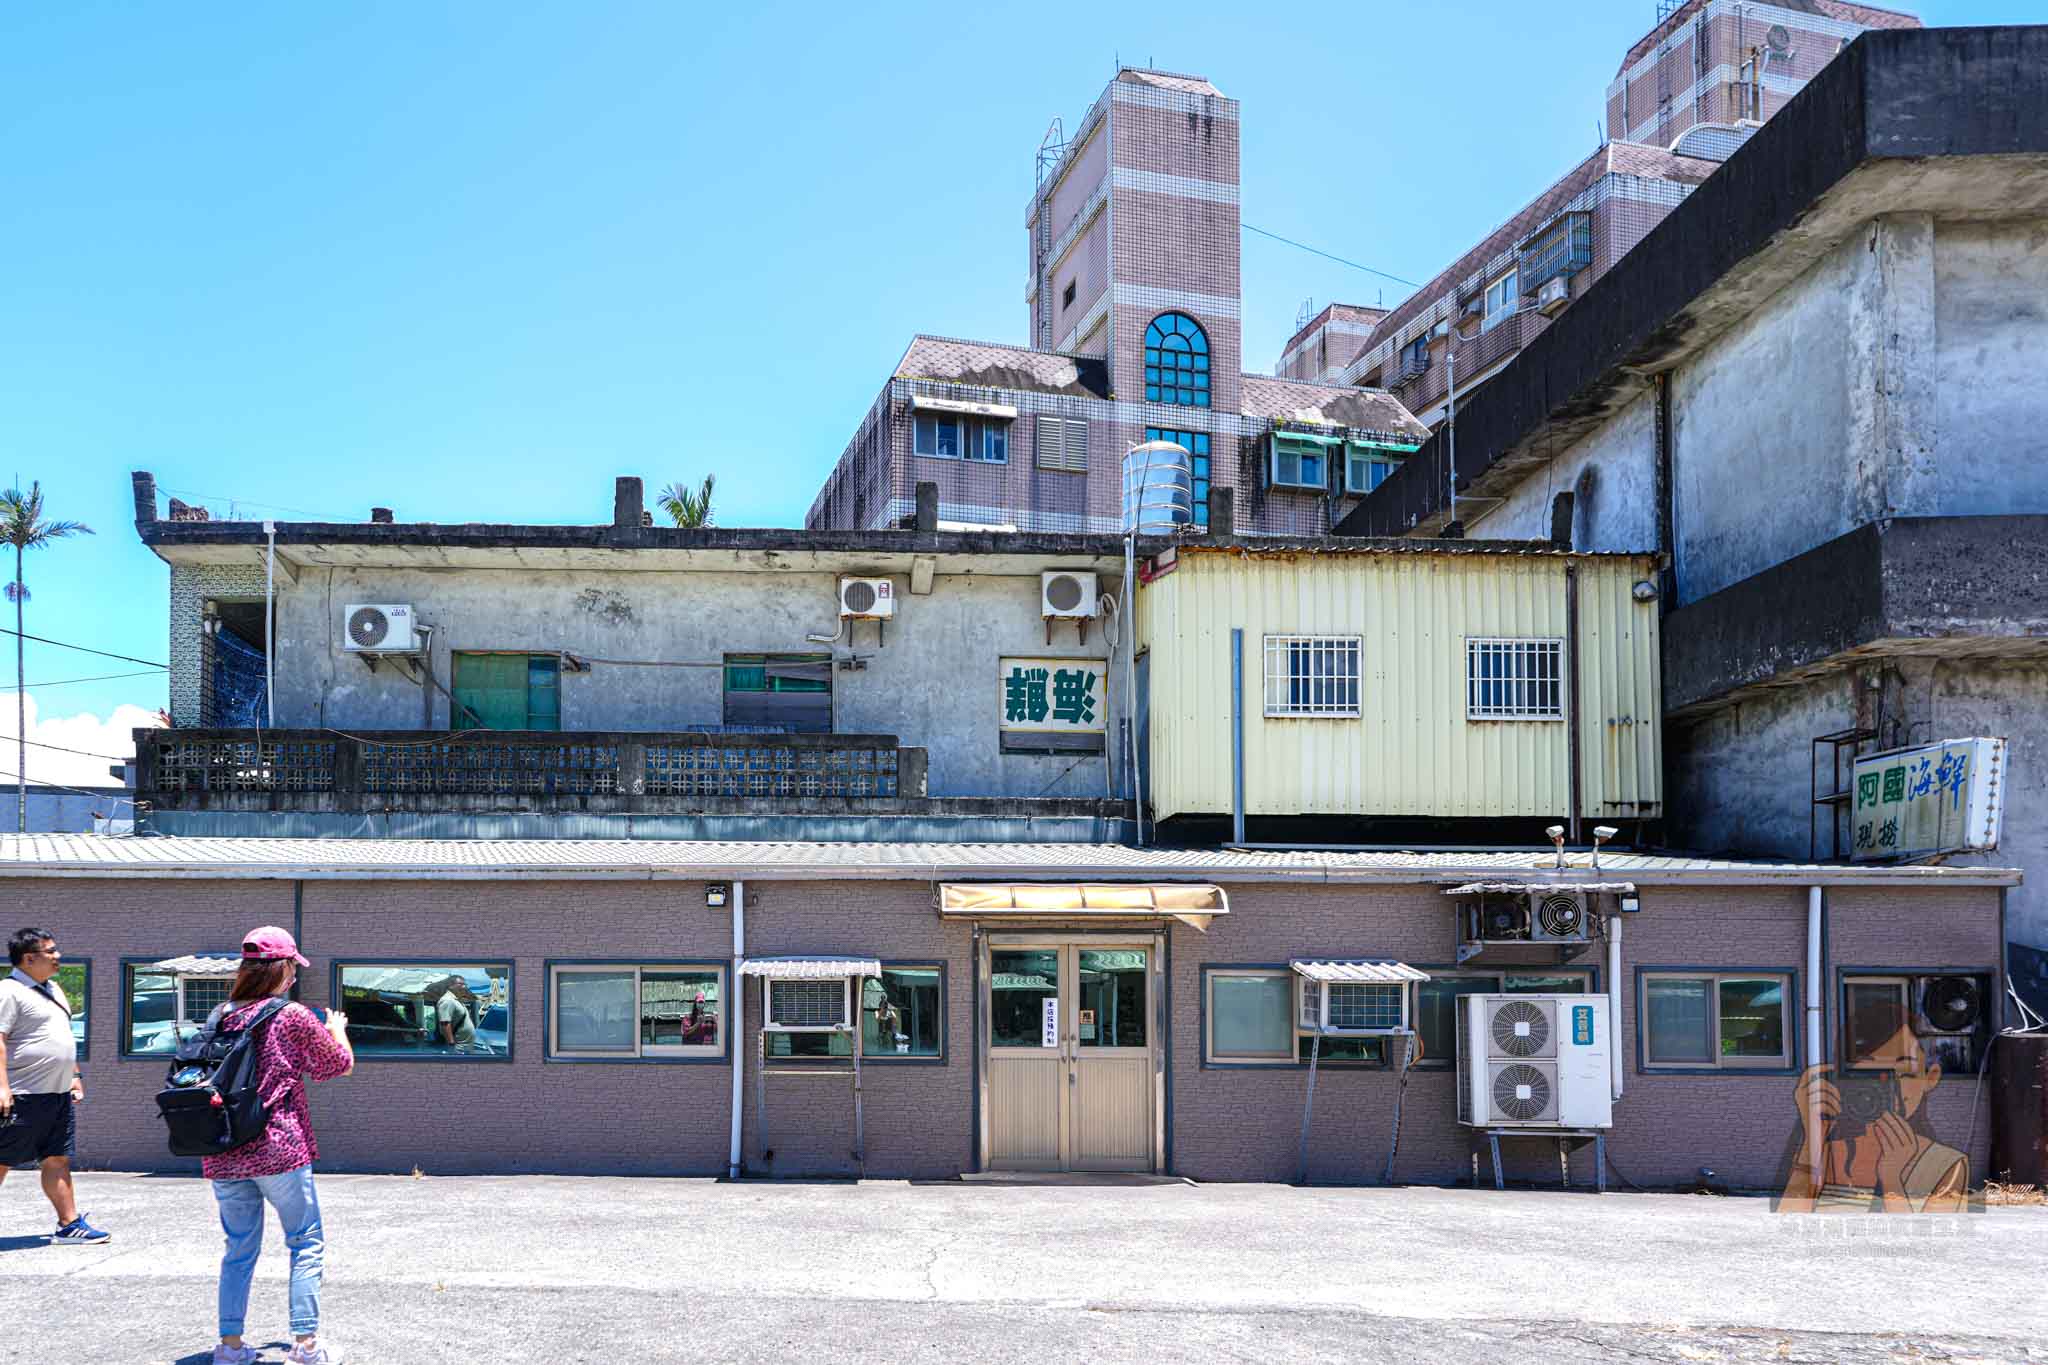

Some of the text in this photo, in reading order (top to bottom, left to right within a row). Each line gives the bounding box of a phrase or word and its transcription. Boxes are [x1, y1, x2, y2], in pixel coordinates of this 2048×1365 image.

[1006, 667, 1096, 724] 海鮮
[1858, 751, 1967, 811] 阿國海鮮
[1857, 816, 1898, 849] 現撈
